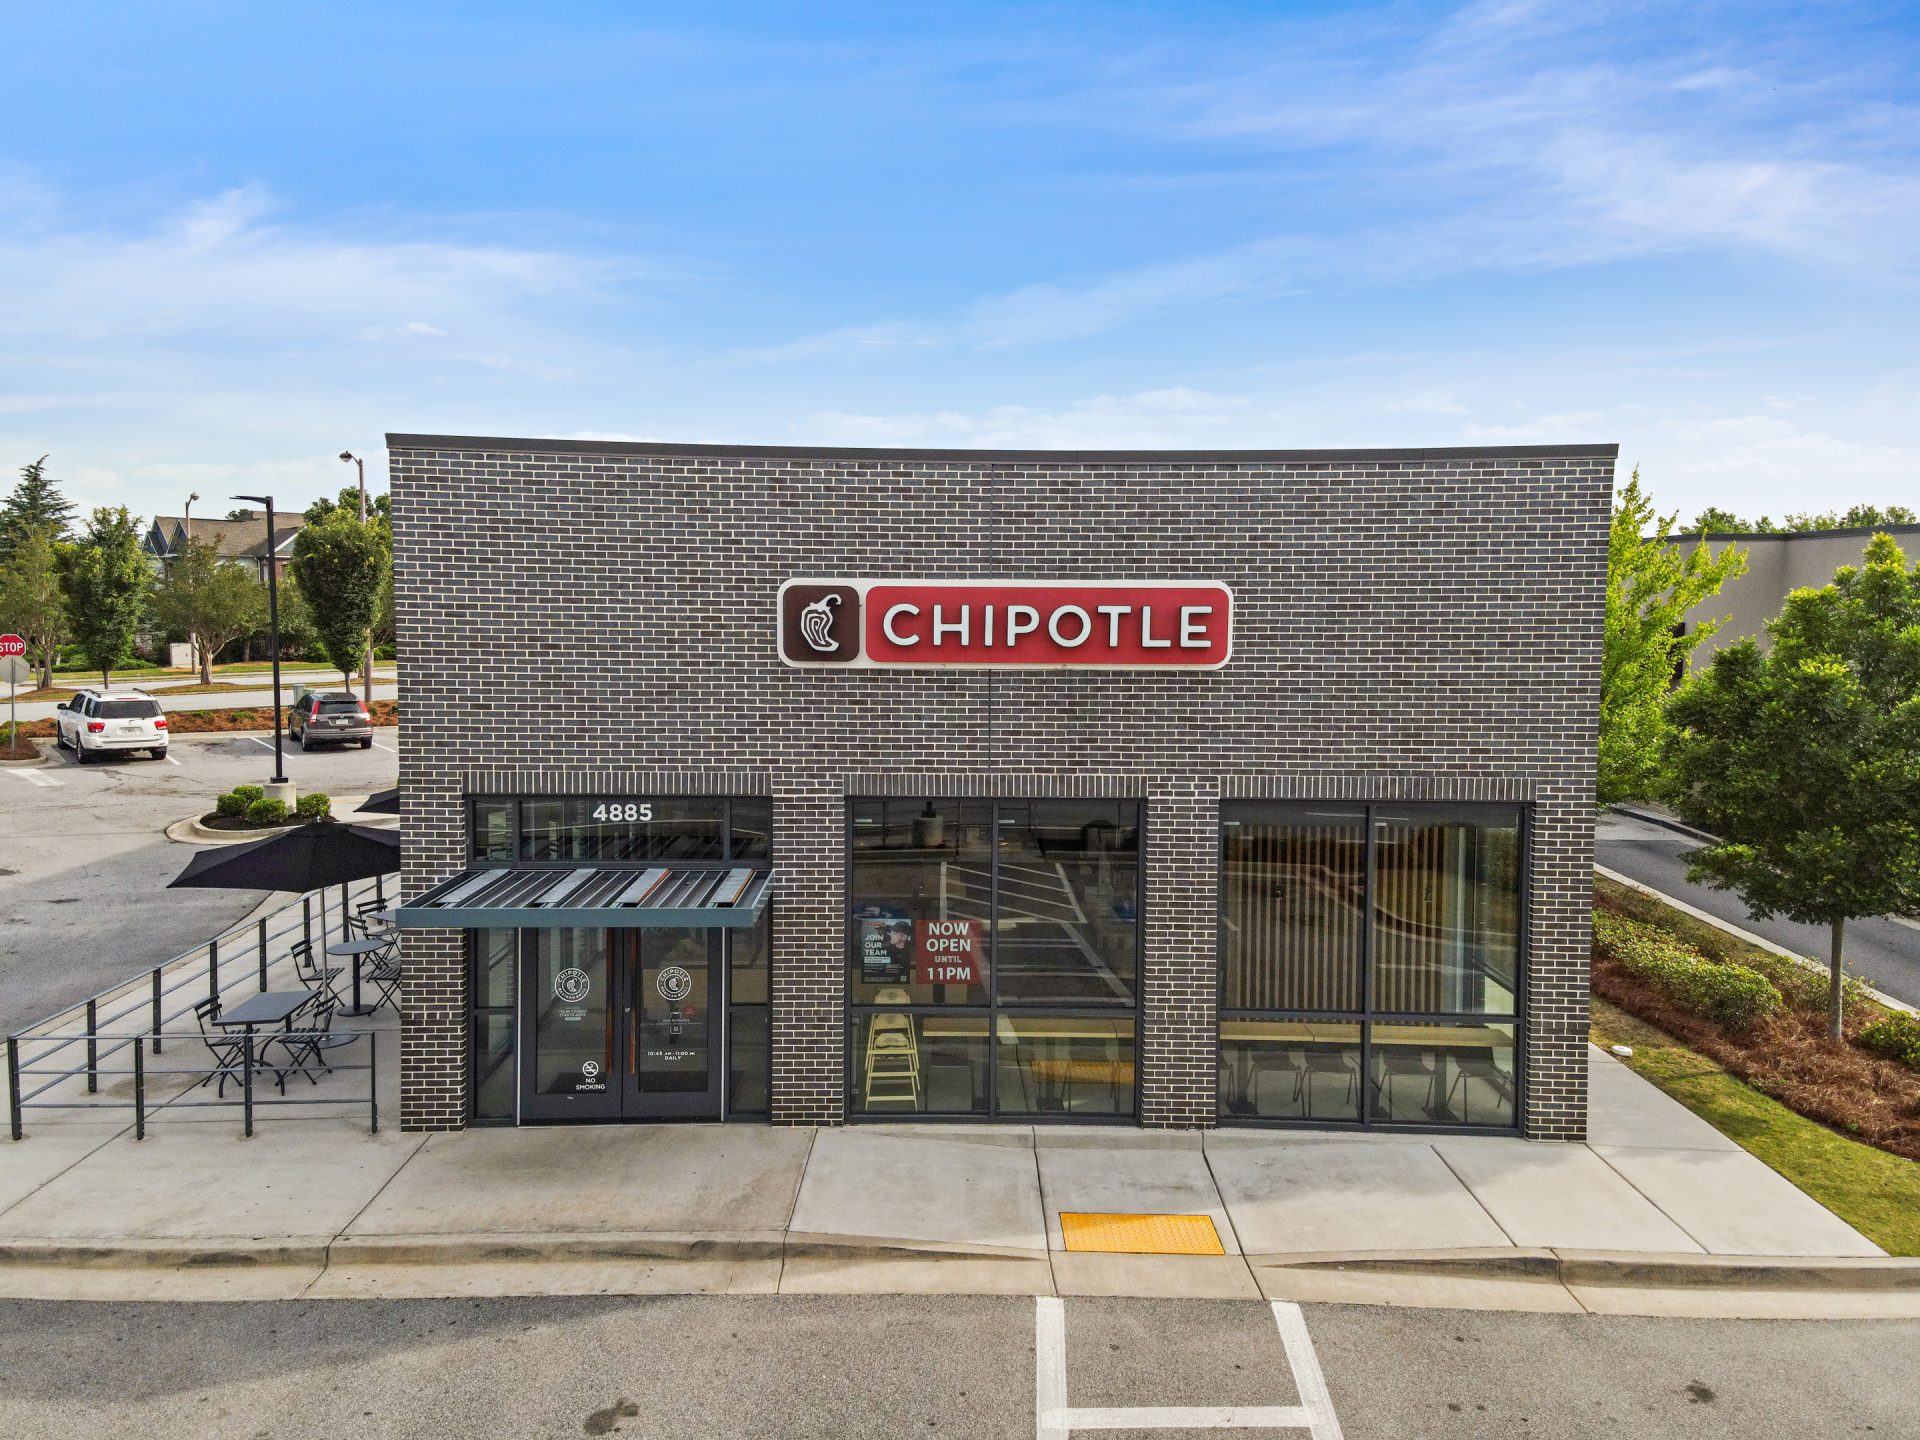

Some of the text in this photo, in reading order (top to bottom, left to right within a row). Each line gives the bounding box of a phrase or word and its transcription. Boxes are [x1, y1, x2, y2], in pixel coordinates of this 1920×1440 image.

[883, 603, 1213, 648] CHIPOTLE
[592, 803, 653, 822] 4885
[928, 922, 970, 936] NOW
[926, 938, 971, 952] OPEN
[934, 955, 962, 963] UNTIL
[558, 970, 588, 983] CHIPOTLE
[660, 969, 688, 982] CHIPOTLE
[927, 967, 971, 980] 11PM
